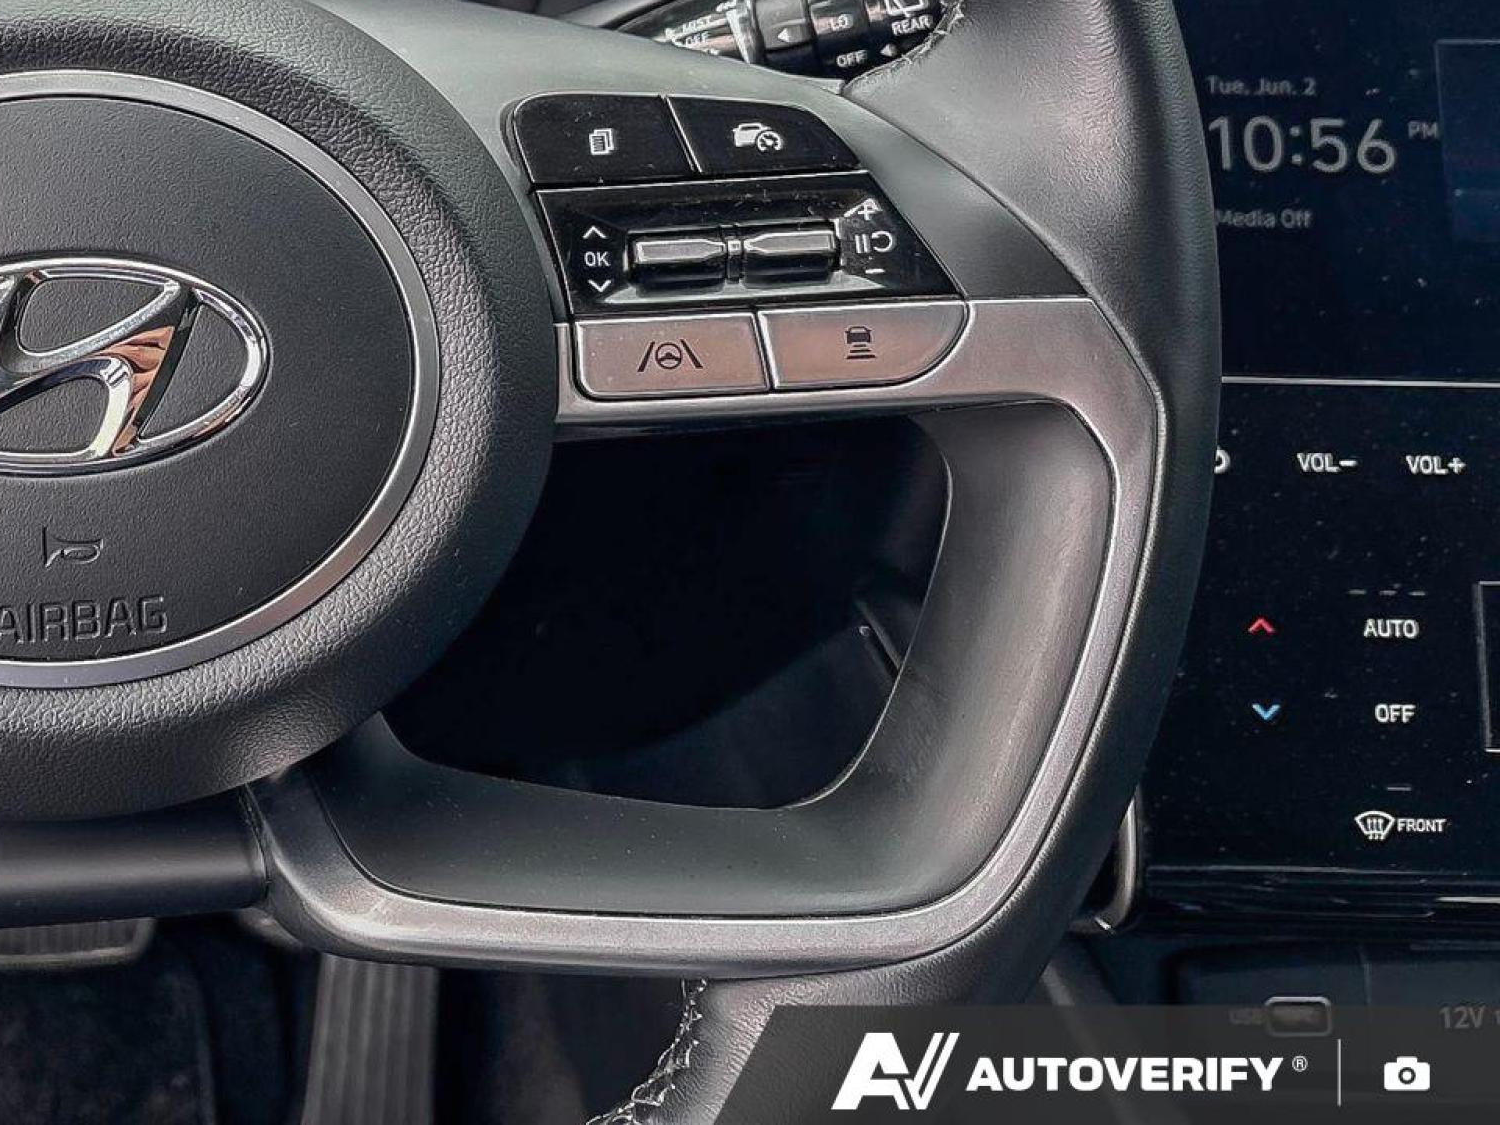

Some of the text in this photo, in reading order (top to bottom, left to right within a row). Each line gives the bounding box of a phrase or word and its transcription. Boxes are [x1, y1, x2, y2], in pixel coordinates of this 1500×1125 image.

[891, 14, 933, 36] REAR
[836, 49, 868, 68] OFF
[1257, 78, 1297, 95] Jun.
[1304, 77, 1316, 95] 2
[1407, 120, 1440, 139] PM
[1208, 115, 1396, 174] 10:56
[1216, 209, 1312, 227] Media Off
[584, 251, 611, 267] OK
[1363, 618, 1420, 639] AUTO
[1375, 703, 1416, 723] OFF
[1397, 818, 1447, 832] FRONT
[1440, 1004, 1486, 1028] 12V
